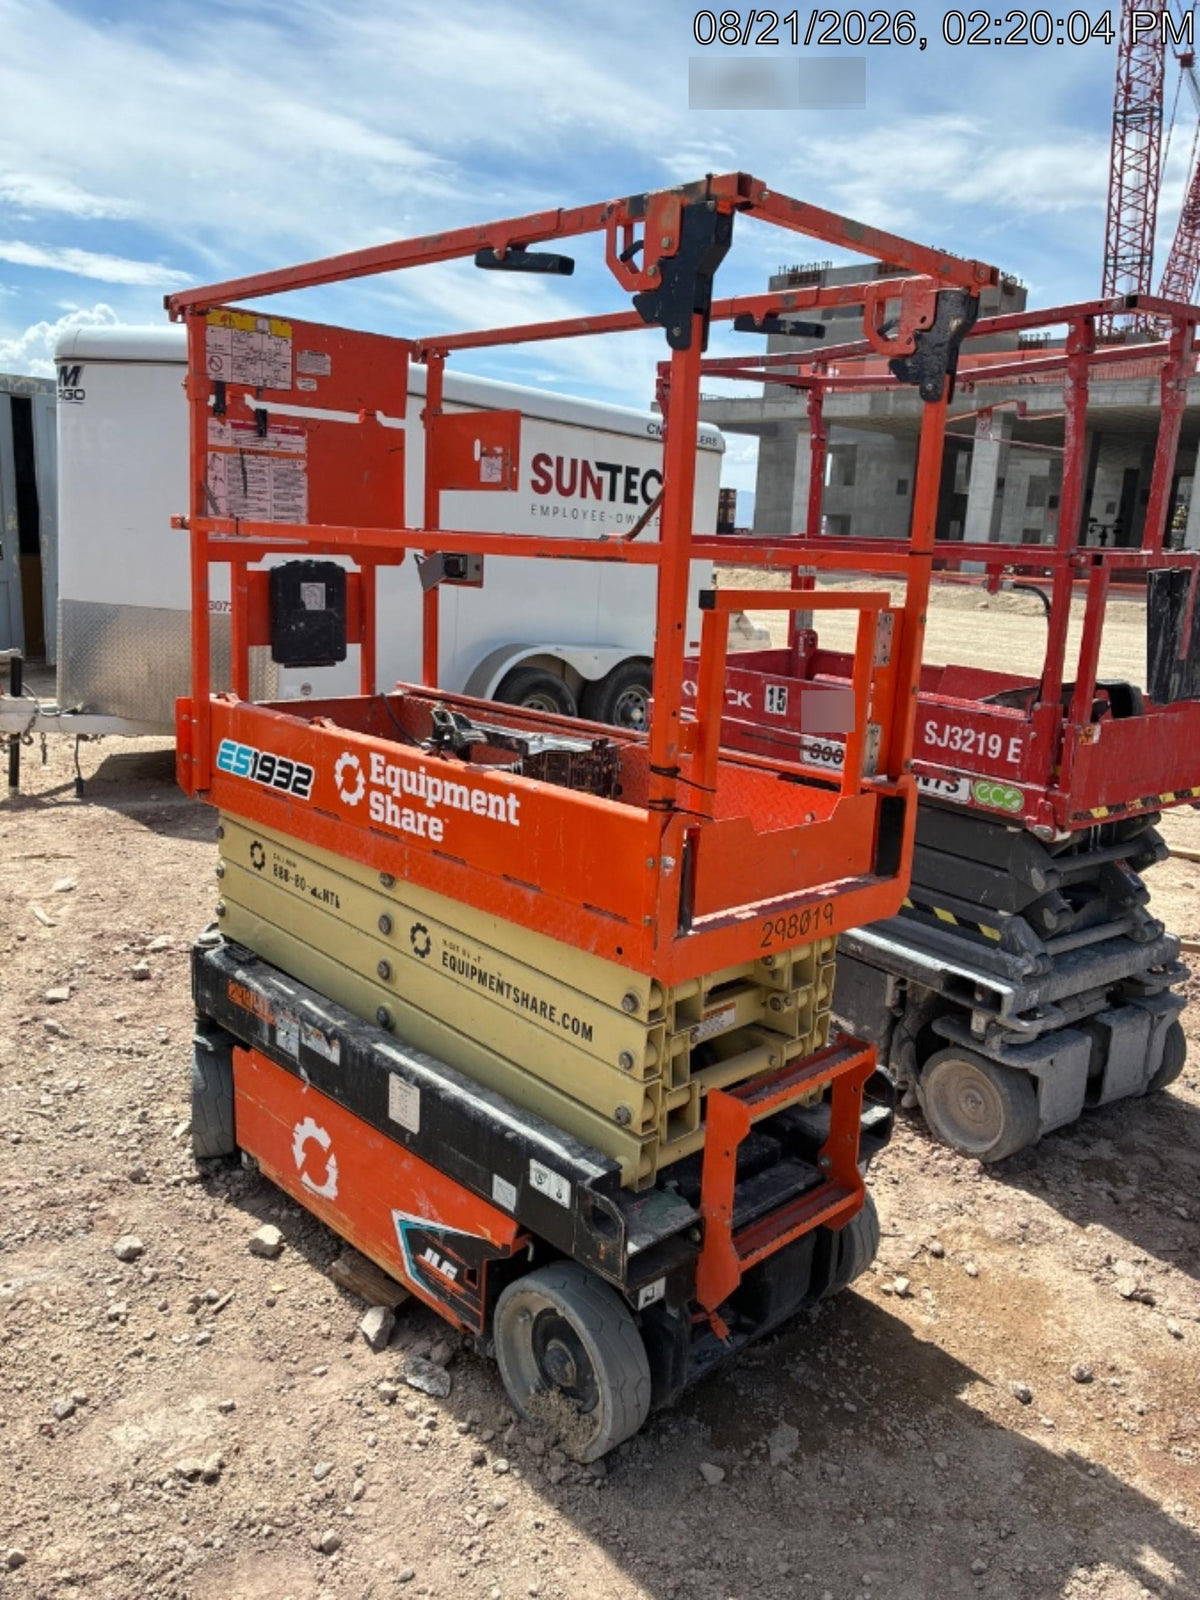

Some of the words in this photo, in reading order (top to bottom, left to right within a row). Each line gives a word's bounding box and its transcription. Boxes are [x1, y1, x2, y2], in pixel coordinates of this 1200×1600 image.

[216, 739, 314, 800] ES1932
[924, 720, 1002, 759] SJ3219
[1006, 737, 1023, 764] E
[369, 752, 520, 827] Equipment
[369, 790, 445, 843] Share
[761, 902, 834, 948] 298019
[442, 951, 593, 1042] EQUIPMENTSHARE.COM
